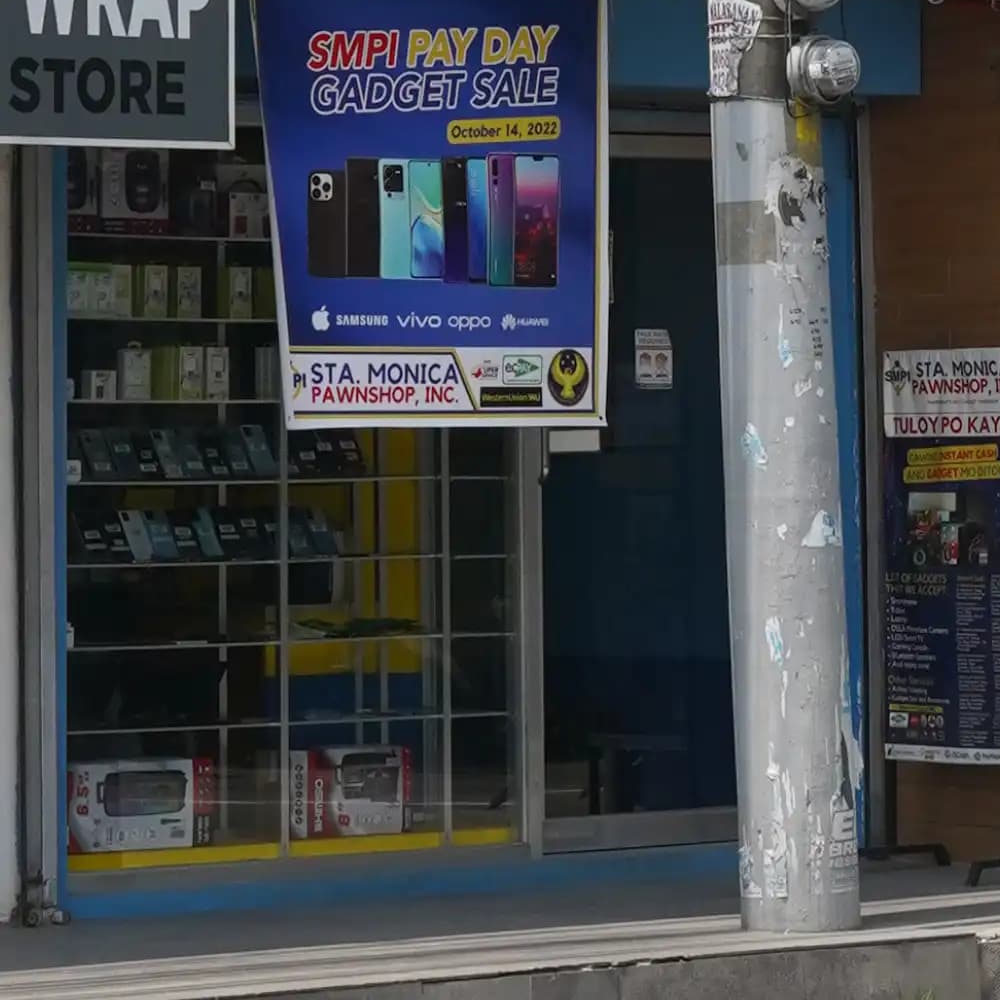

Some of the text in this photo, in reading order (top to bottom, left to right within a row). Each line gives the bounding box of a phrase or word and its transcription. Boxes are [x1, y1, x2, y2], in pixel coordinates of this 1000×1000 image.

[307, 25, 559, 72] SMPI PAY DAY
[9, 57, 186, 116] STORE
[310, 67, 559, 115] GADGET SALE
[451, 121, 557, 139] October 14, 2022
[335, 314, 388, 326] SAMSUNG
[396, 314, 441, 328] vivo
[448, 315, 491, 331] oppo
[517, 318, 549, 327] HUAWEI
[311, 363, 360, 384] STA.
[368, 363, 459, 384] MONICA
[885, 369, 911, 382] SMPI
[916, 360, 947, 378] STA.
[312, 386, 458, 405] PAWNSHOP, INC.
[912, 378, 992, 395] PAWNSHOP,
